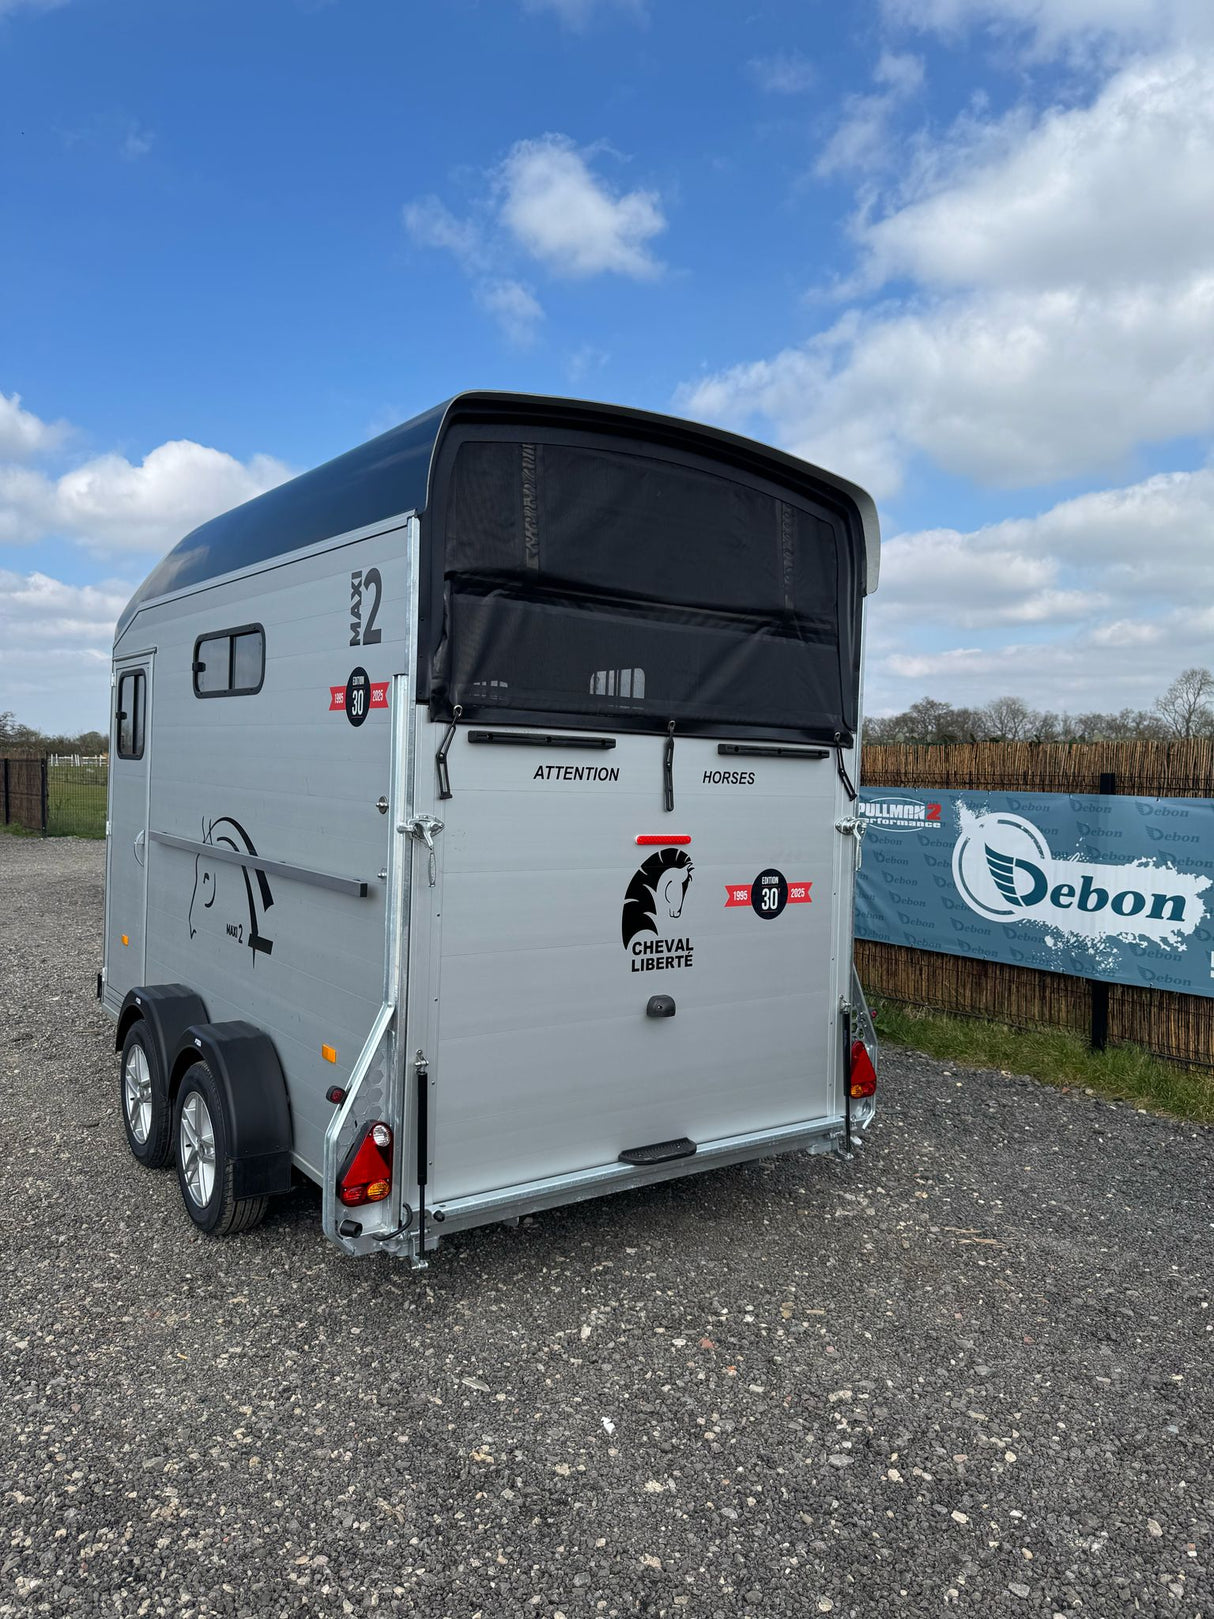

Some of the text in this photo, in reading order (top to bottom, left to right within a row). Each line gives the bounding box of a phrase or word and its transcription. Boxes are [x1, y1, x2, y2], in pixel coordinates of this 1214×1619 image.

[350, 567, 382, 646] MAXI 2
[351, 689, 364, 716] 30
[372, 689, 384, 702] 2025
[533, 765, 756, 785] ATTENTION HORSES
[859, 802, 942, 820] PULLMAN 2
[1069, 799, 1112, 814] Debon
[1135, 801, 1189, 818] Debon
[865, 818, 941, 829] erformance
[1076, 821, 1123, 838] Debon
[1145, 825, 1200, 844] Debon
[761, 876, 779, 885] EDITION
[984, 842, 1187, 922] Debon
[733, 890, 748, 901] 1995
[761, 888, 779, 910] 30
[790, 888, 805, 898] 2025
[888, 891, 926, 907] Debon
[897, 911, 935, 929] Debon
[950, 917, 991, 936] Debon
[632, 938, 694, 956] CHEVAL
[631, 951, 693, 972] LIBERTÉ
[1136, 965, 1192, 987] Debon
